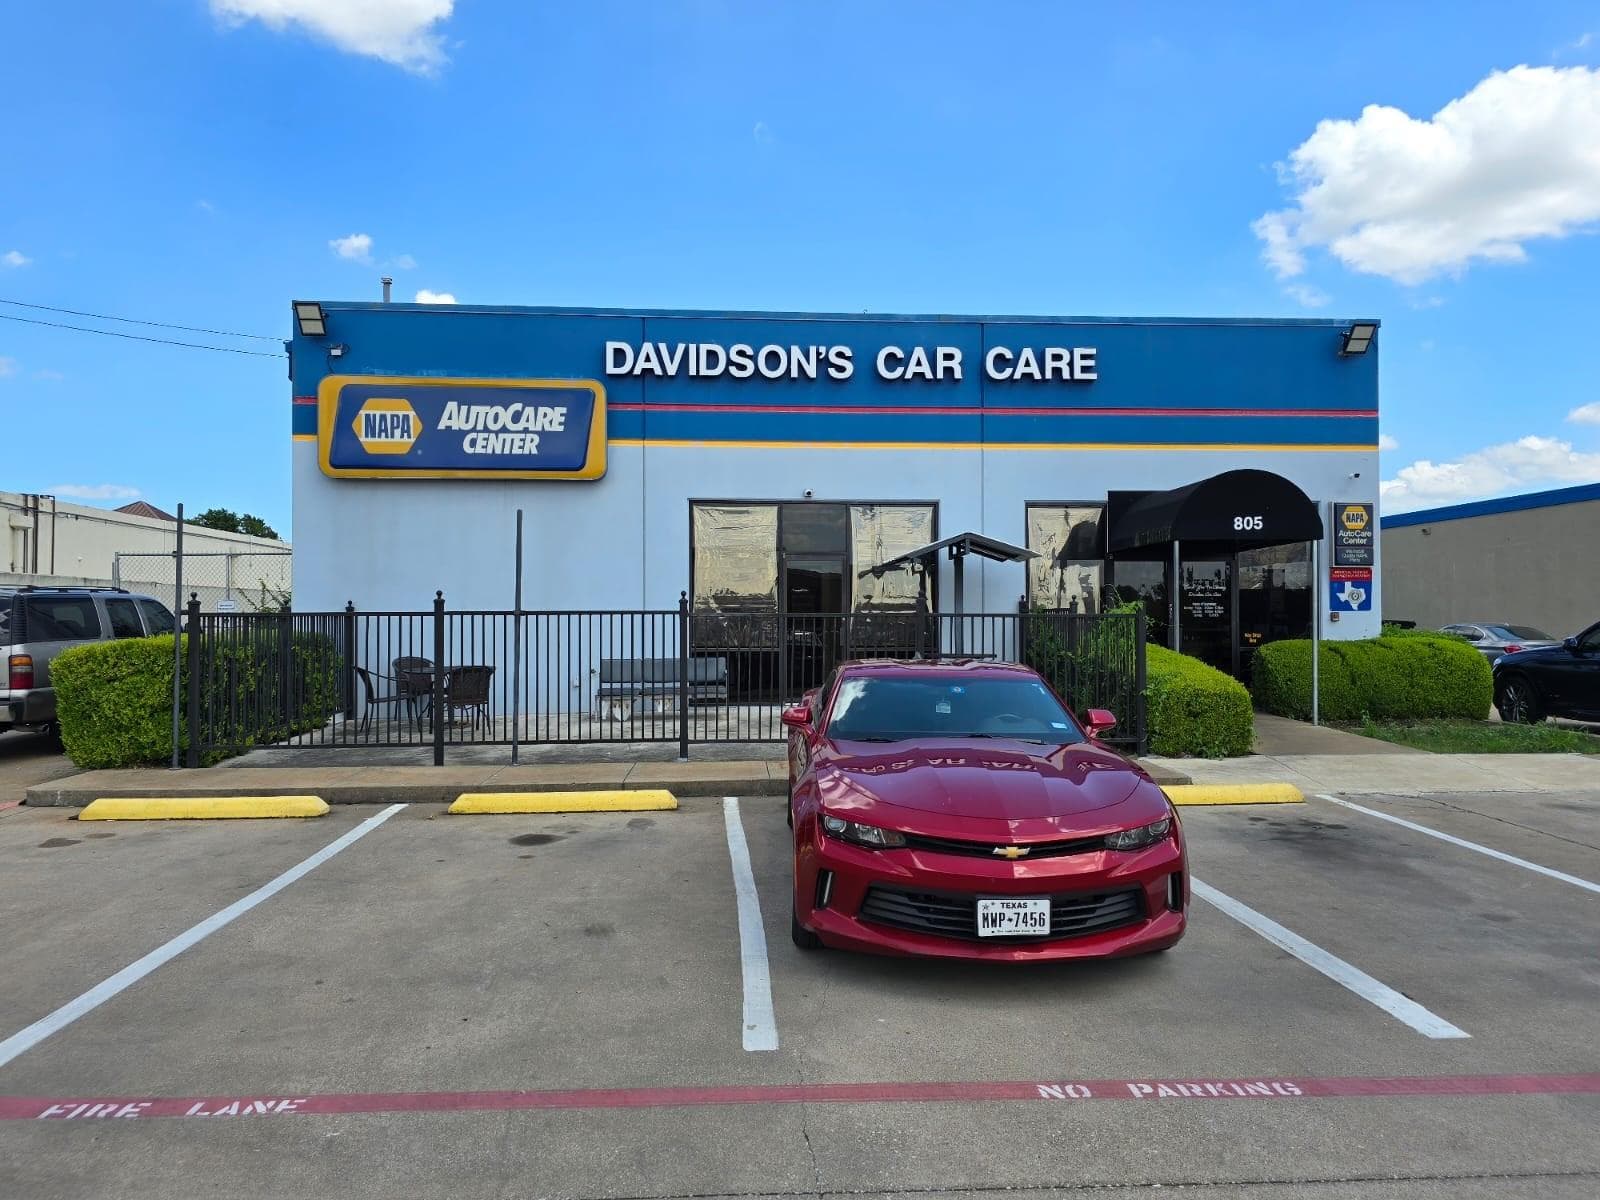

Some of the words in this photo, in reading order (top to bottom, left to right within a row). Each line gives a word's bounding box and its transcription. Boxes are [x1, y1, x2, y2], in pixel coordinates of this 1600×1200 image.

[605, 341, 854, 379] DAVIDSON'S
[876, 346, 963, 380] CAR
[985, 346, 1098, 380] CARE
[363, 412, 412, 439] NAPA
[462, 432, 540, 455] CENTER
[1233, 516, 1264, 530] 805
[1345, 512, 1364, 523] NAPA
[1037, 1084, 1092, 1099] NO
[1127, 1082, 1302, 1098] PARKING
[36, 1102, 152, 1119] FIRE
[185, 1099, 306, 1116] LANE
